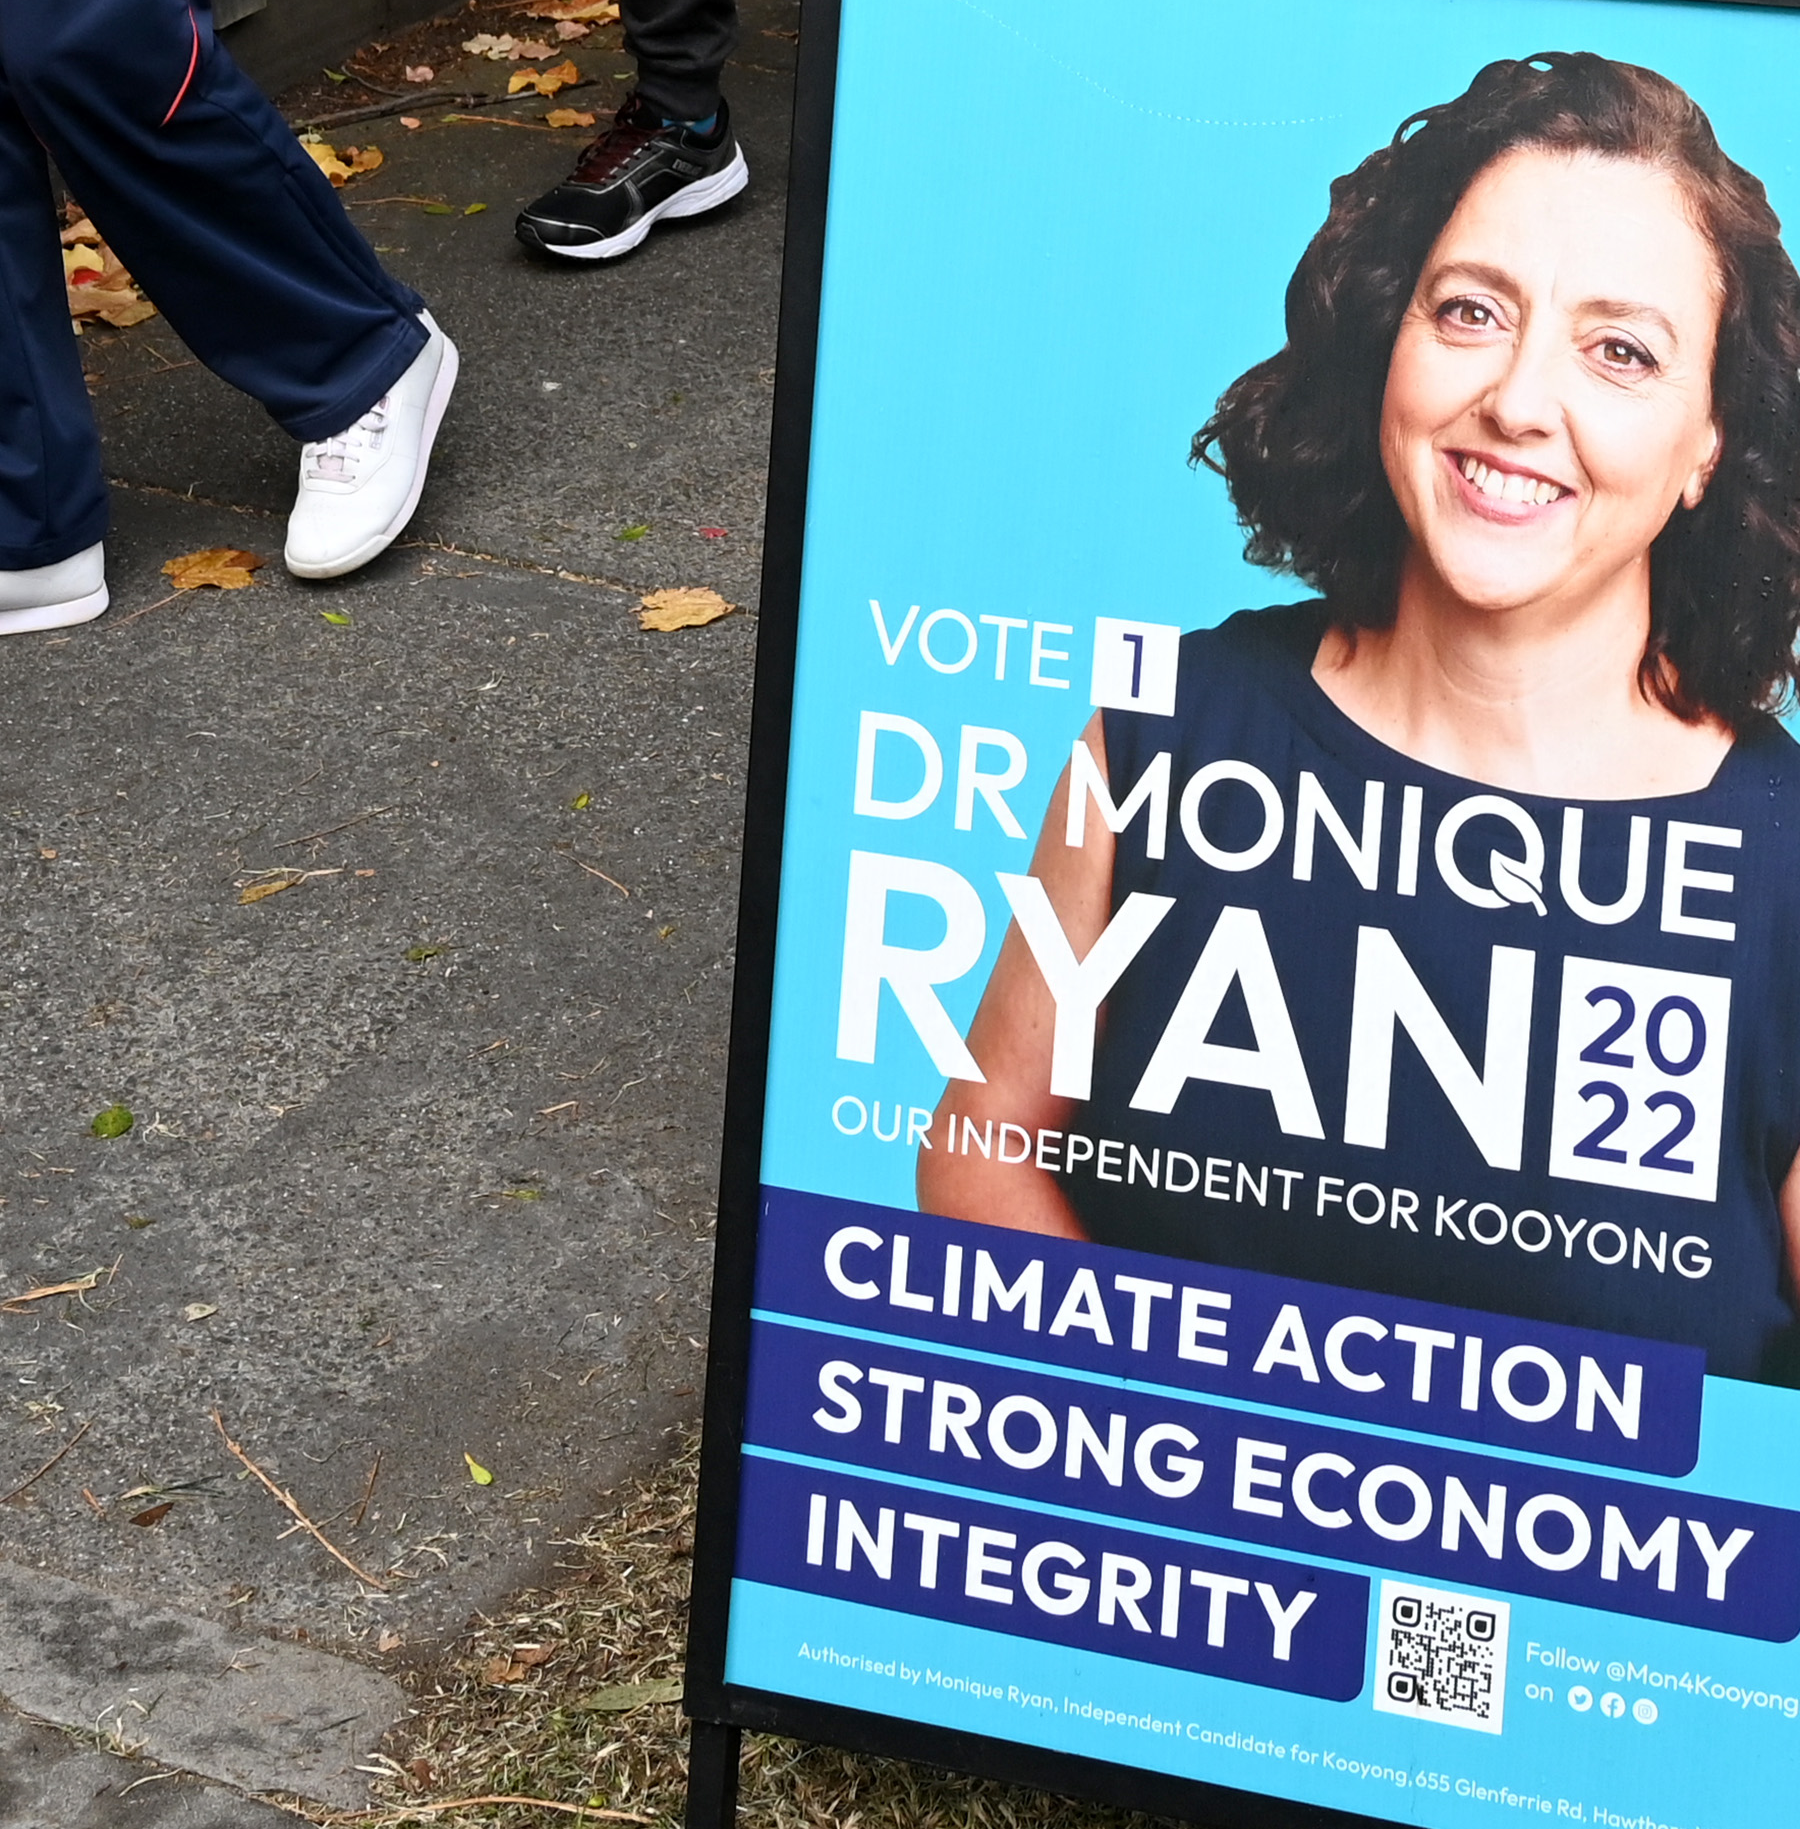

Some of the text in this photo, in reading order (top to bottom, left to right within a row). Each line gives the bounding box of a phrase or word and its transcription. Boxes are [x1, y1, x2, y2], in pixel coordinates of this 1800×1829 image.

[870, 600, 1142, 697] VOTE 1
[855, 711, 1742, 939] DR MONIQUE
[835, 850, 1537, 1171] RYAN
[1580, 986, 1706, 1076] 20
[833, 1096, 1711, 1278] OUR INDEPENDENT FOR KOOYONG
[1574, 1081, 1695, 1174] 22
[825, 1227, 1642, 1439] CLIMATE ACTION
[813, 1361, 1753, 1600] STRONG ECONOMY
[807, 1494, 1316, 1660] INTEGRITY
[798, 1641, 896, 1677] Authorised
[899, 1661, 921, 1686] by
[925, 1667, 1004, 1700] Monique
[1007, 1685, 1059, 1715] Ryan,
[1063, 1696, 1182, 1737] Independent
[1186, 1722, 1286, 1760] Candidate
[1290, 1743, 1320, 1766] for
[1322, 1750, 1413, 1788] Kooyong,
[1415, 1769, 1451, 1794] 655
[1454, 1778, 1553, 1815] Glenferrie
[1556, 1797, 1588, 1824] Rd,
[1524, 1683, 1554, 1703] on
[1526, 1641, 1799, 1718] Follow @Mon4Kooyong
